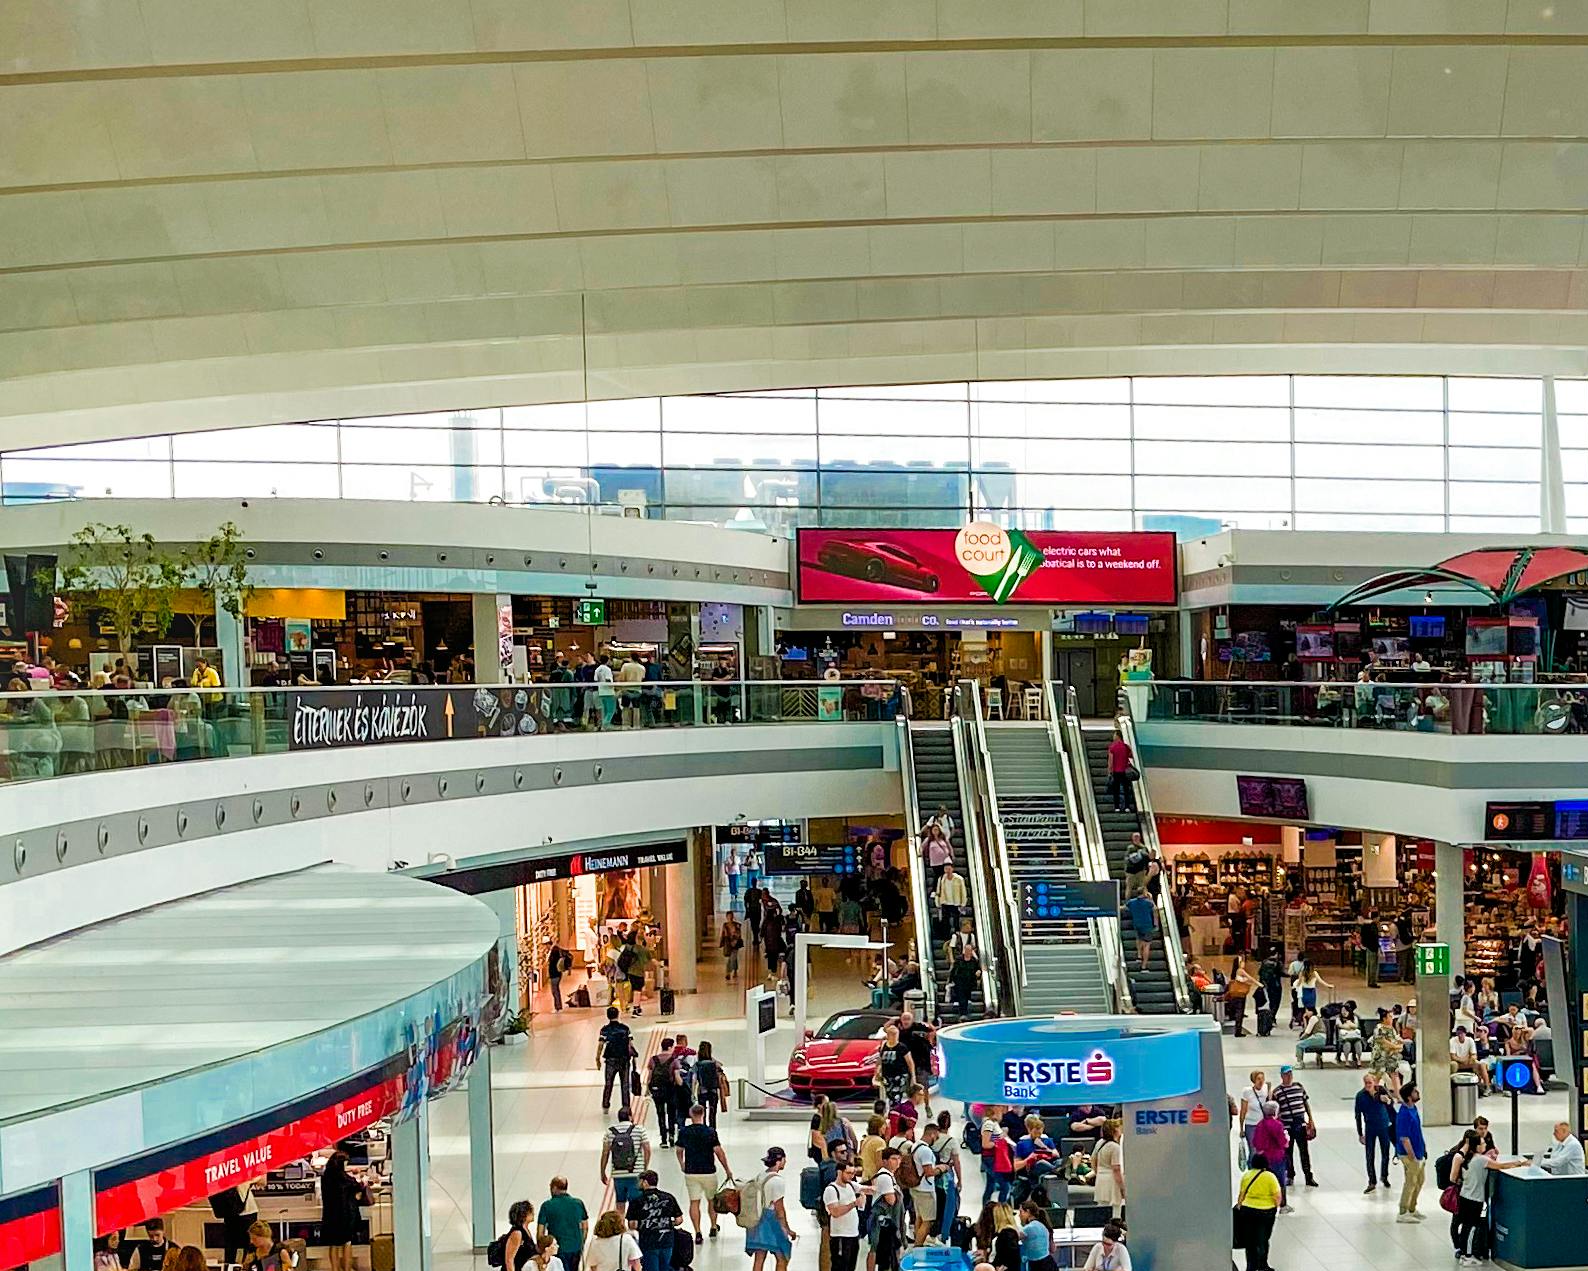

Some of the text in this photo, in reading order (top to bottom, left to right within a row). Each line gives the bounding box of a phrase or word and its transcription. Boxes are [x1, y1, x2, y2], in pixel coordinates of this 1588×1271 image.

[964, 531, 1001, 546] food
[962, 548, 1004, 562] court
[1043, 546, 1121, 557] electric cars what
[1077, 558, 1085, 568] is
[1086, 559, 1096, 568] to
[1098, 561, 1104, 569] a
[1105, 558, 1144, 569] weekend
[1146, 558, 1162, 569] off.
[842, 613, 893, 625] Camden
[294, 693, 428, 746] ÉTTERMEK ÉS KÁVÉZÓK
[782, 846, 817, 857] B1-B44
[1004, 1062, 1081, 1083] ERSTE
[1004, 1085, 1037, 1098] Bank
[337, 1099, 373, 1129] DUTY FREE
[1135, 1110, 1188, 1125] ERSTE
[204, 1145, 272, 1185] TRAVEL VALUE
